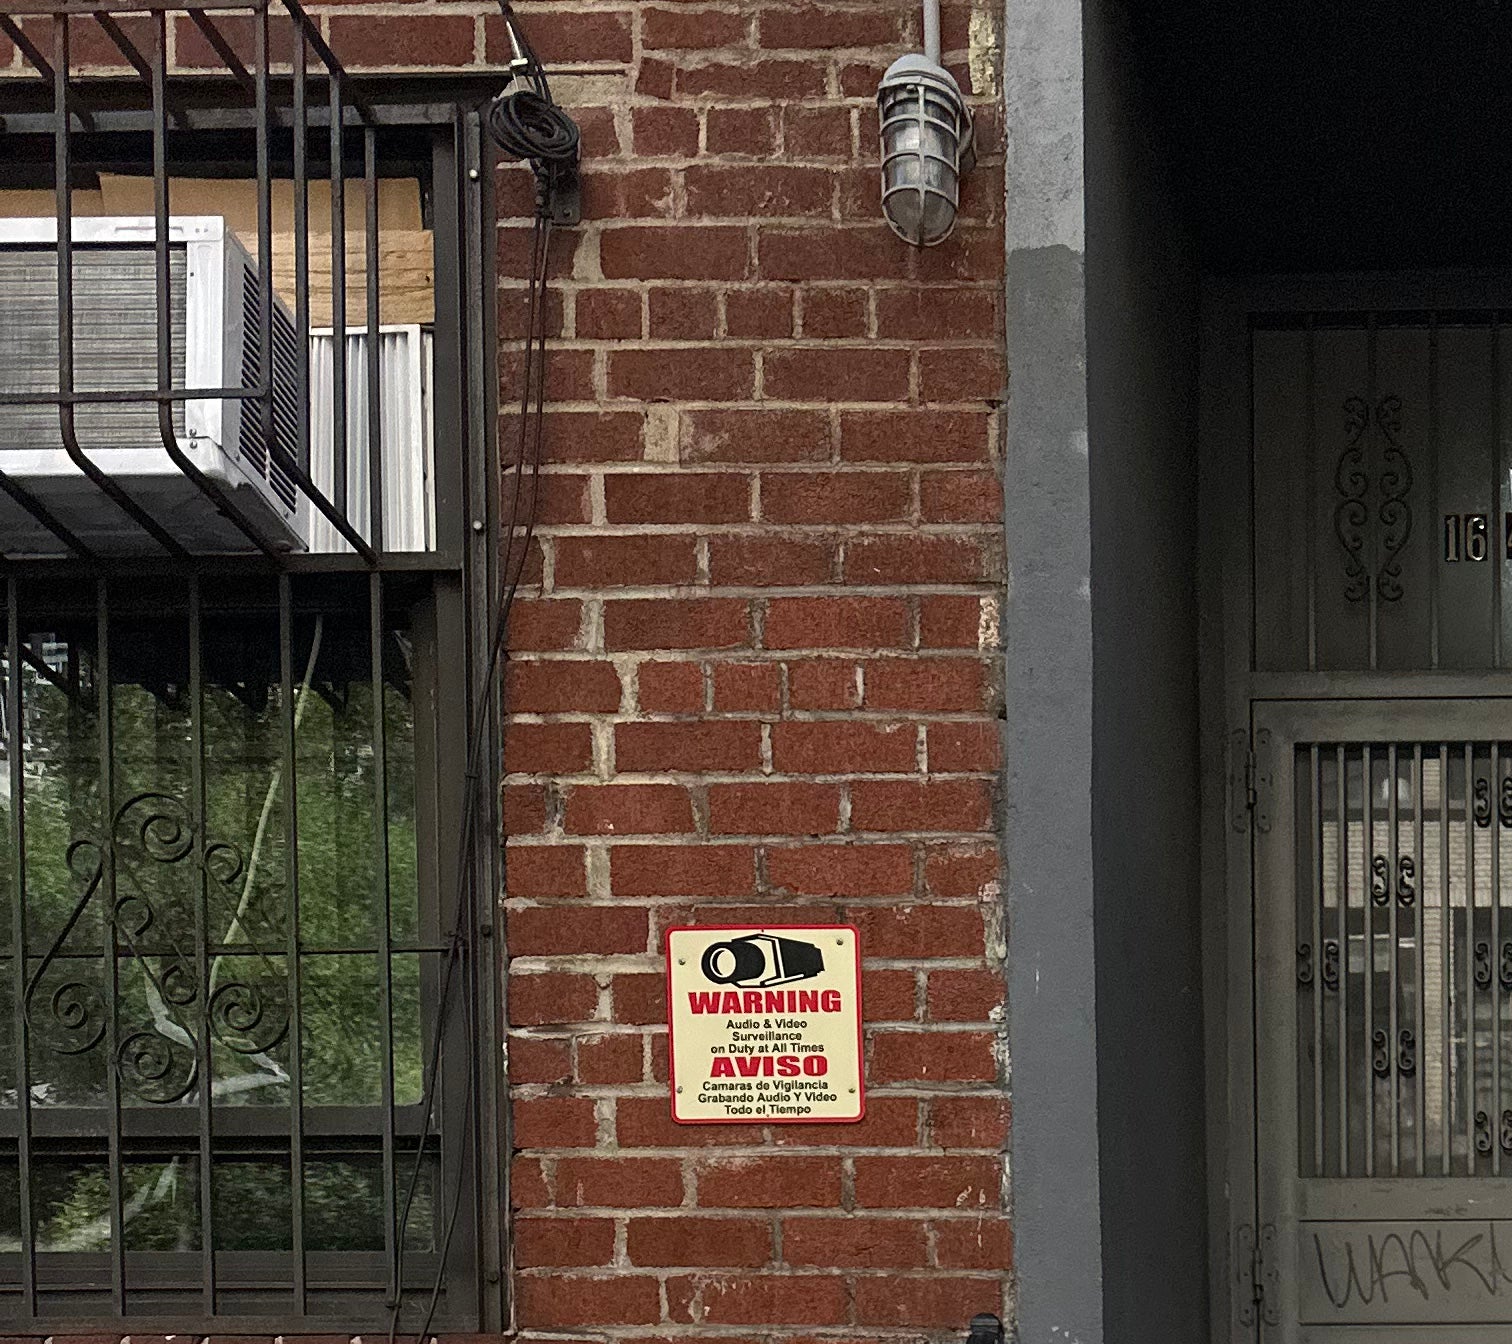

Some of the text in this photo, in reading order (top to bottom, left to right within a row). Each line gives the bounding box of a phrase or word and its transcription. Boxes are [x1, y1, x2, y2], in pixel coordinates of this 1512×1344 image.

[688, 989, 841, 1015] WARNING
[727, 1018, 807, 1029] Audio & Video
[732, 1031, 802, 1041] Surveillance
[711, 1043, 824, 1055] on Duty at All Times
[710, 1055, 828, 1078] AVISO
[703, 1080, 828, 1093] Camaras de Vigilancia
[698, 1091, 837, 1103] Grabando Audio Y Video
[725, 1104, 811, 1116] Todo el Tiempo
